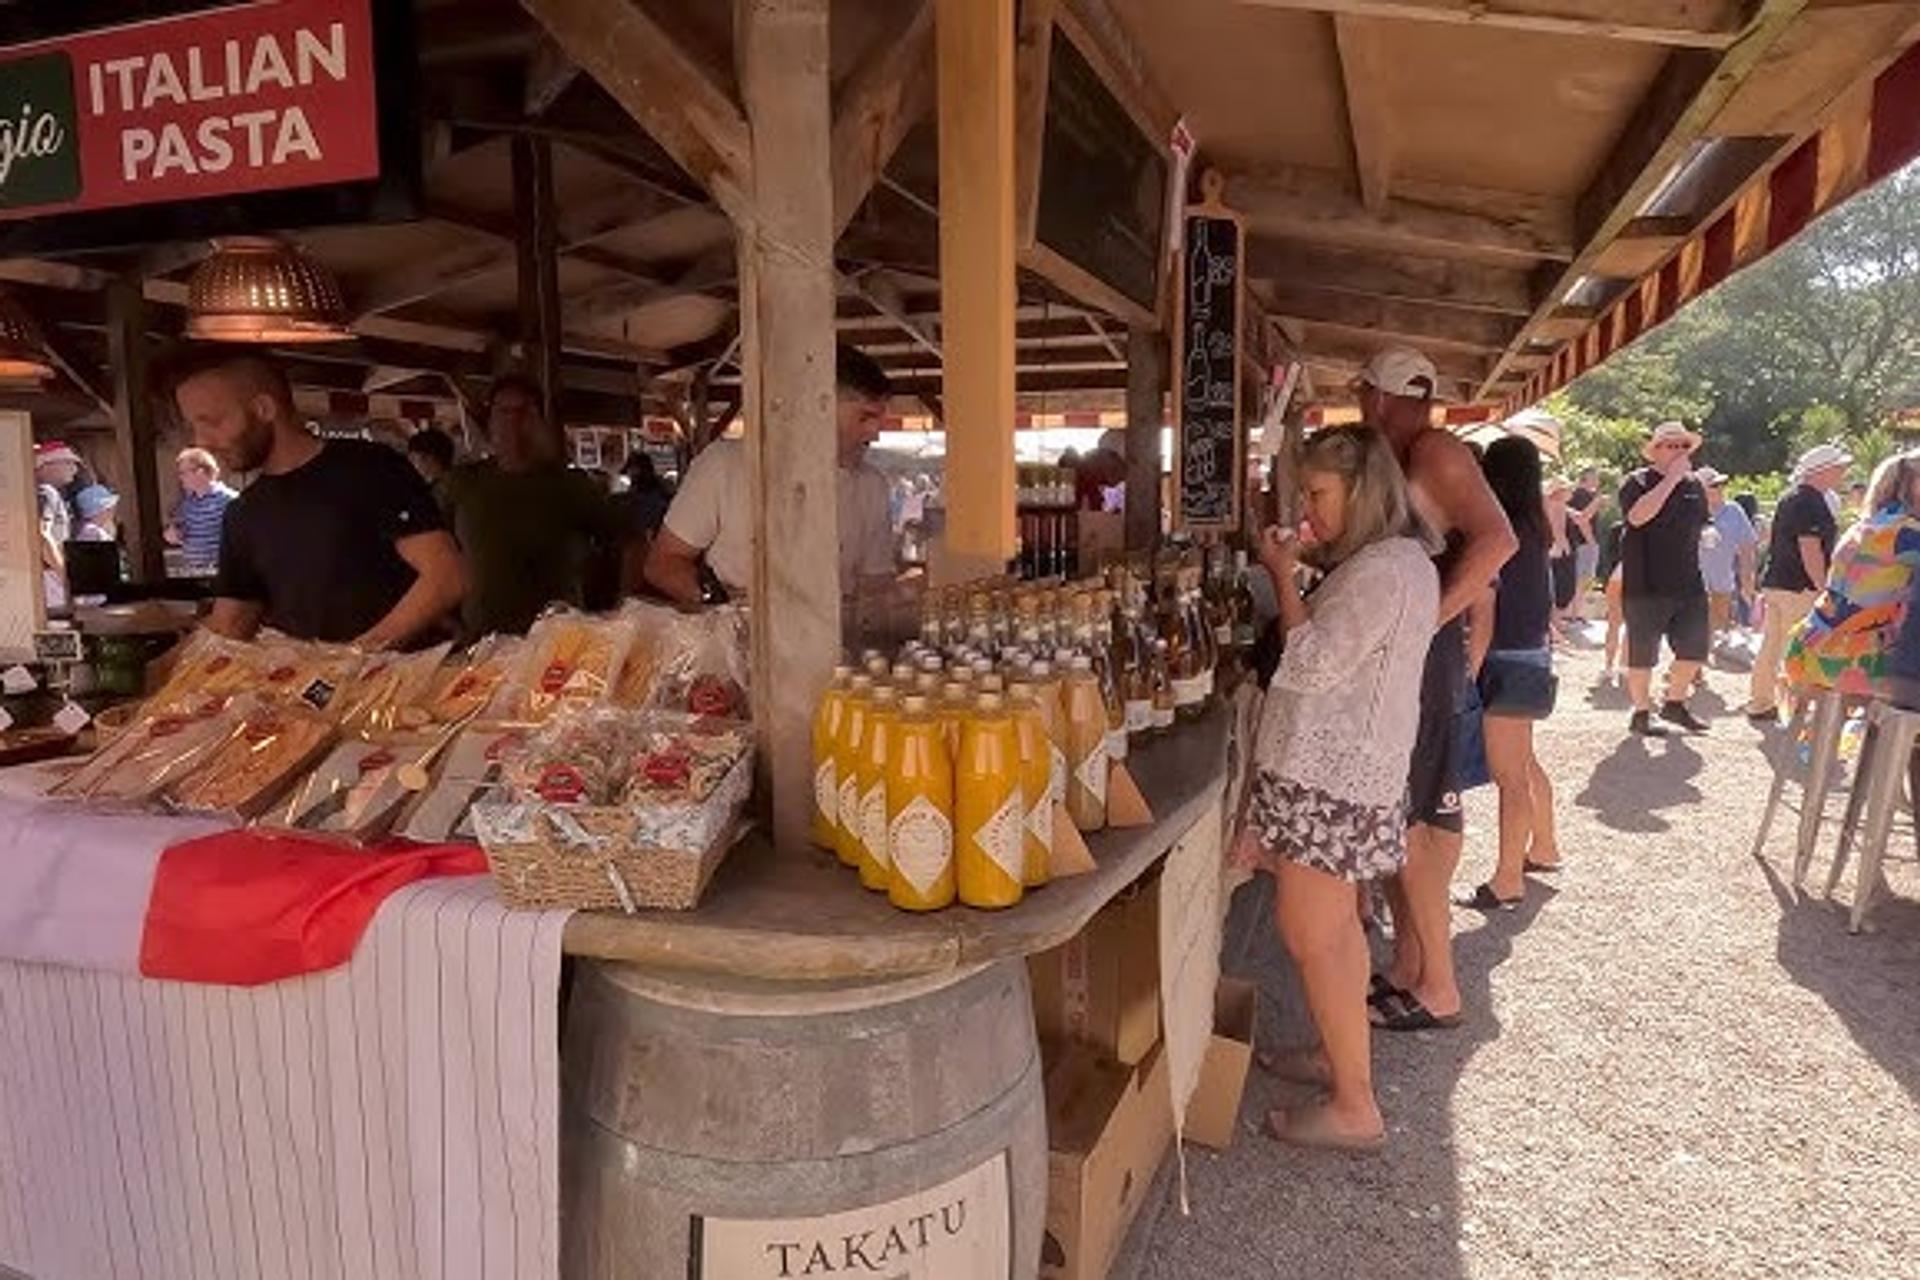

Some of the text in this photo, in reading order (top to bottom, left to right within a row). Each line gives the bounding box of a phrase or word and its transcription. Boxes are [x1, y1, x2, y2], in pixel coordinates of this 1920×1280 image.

[89, 23, 347, 116] ITALIAN
[121, 106, 323, 182] PASTA
[766, 1199, 967, 1277] TAKATU
